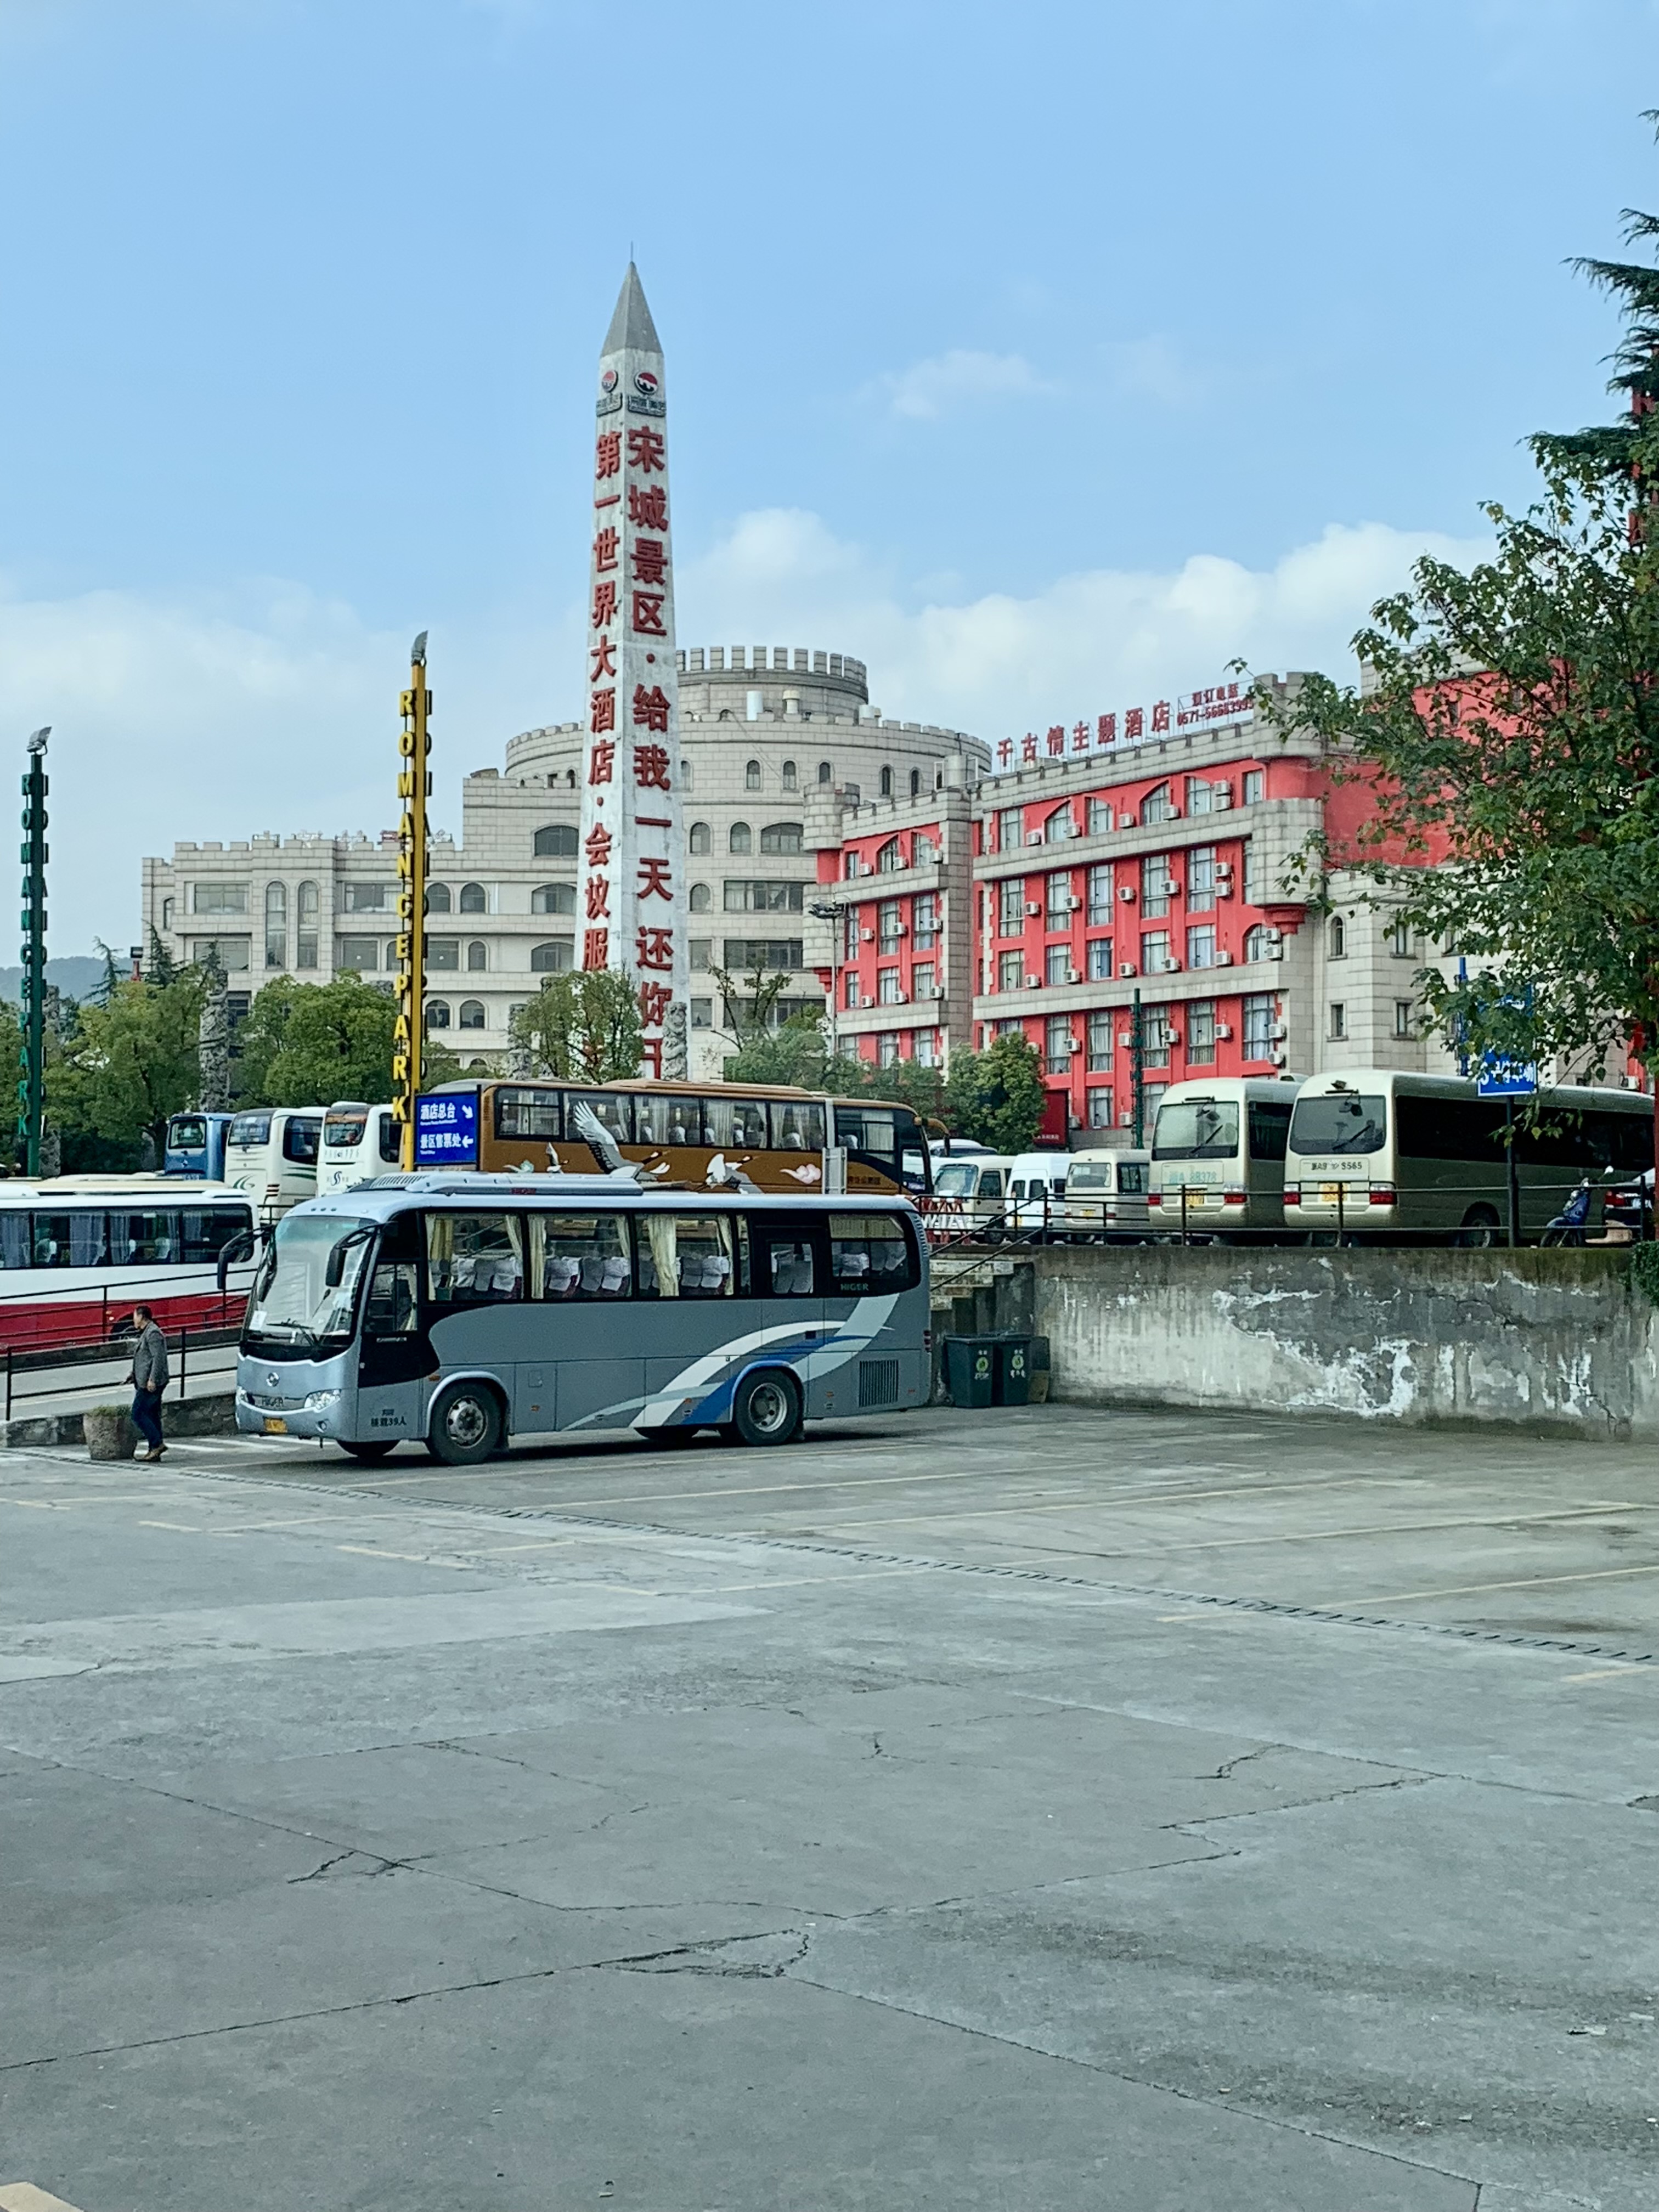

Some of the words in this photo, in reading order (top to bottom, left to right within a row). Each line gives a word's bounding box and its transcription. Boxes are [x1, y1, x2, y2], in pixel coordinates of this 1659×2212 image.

[582, 430, 622, 1067] 第一世界大酒店·会议服
[997, 699, 1170, 768] 千古情主题酒店
[420, 1102, 456, 1120] 酒店总台
